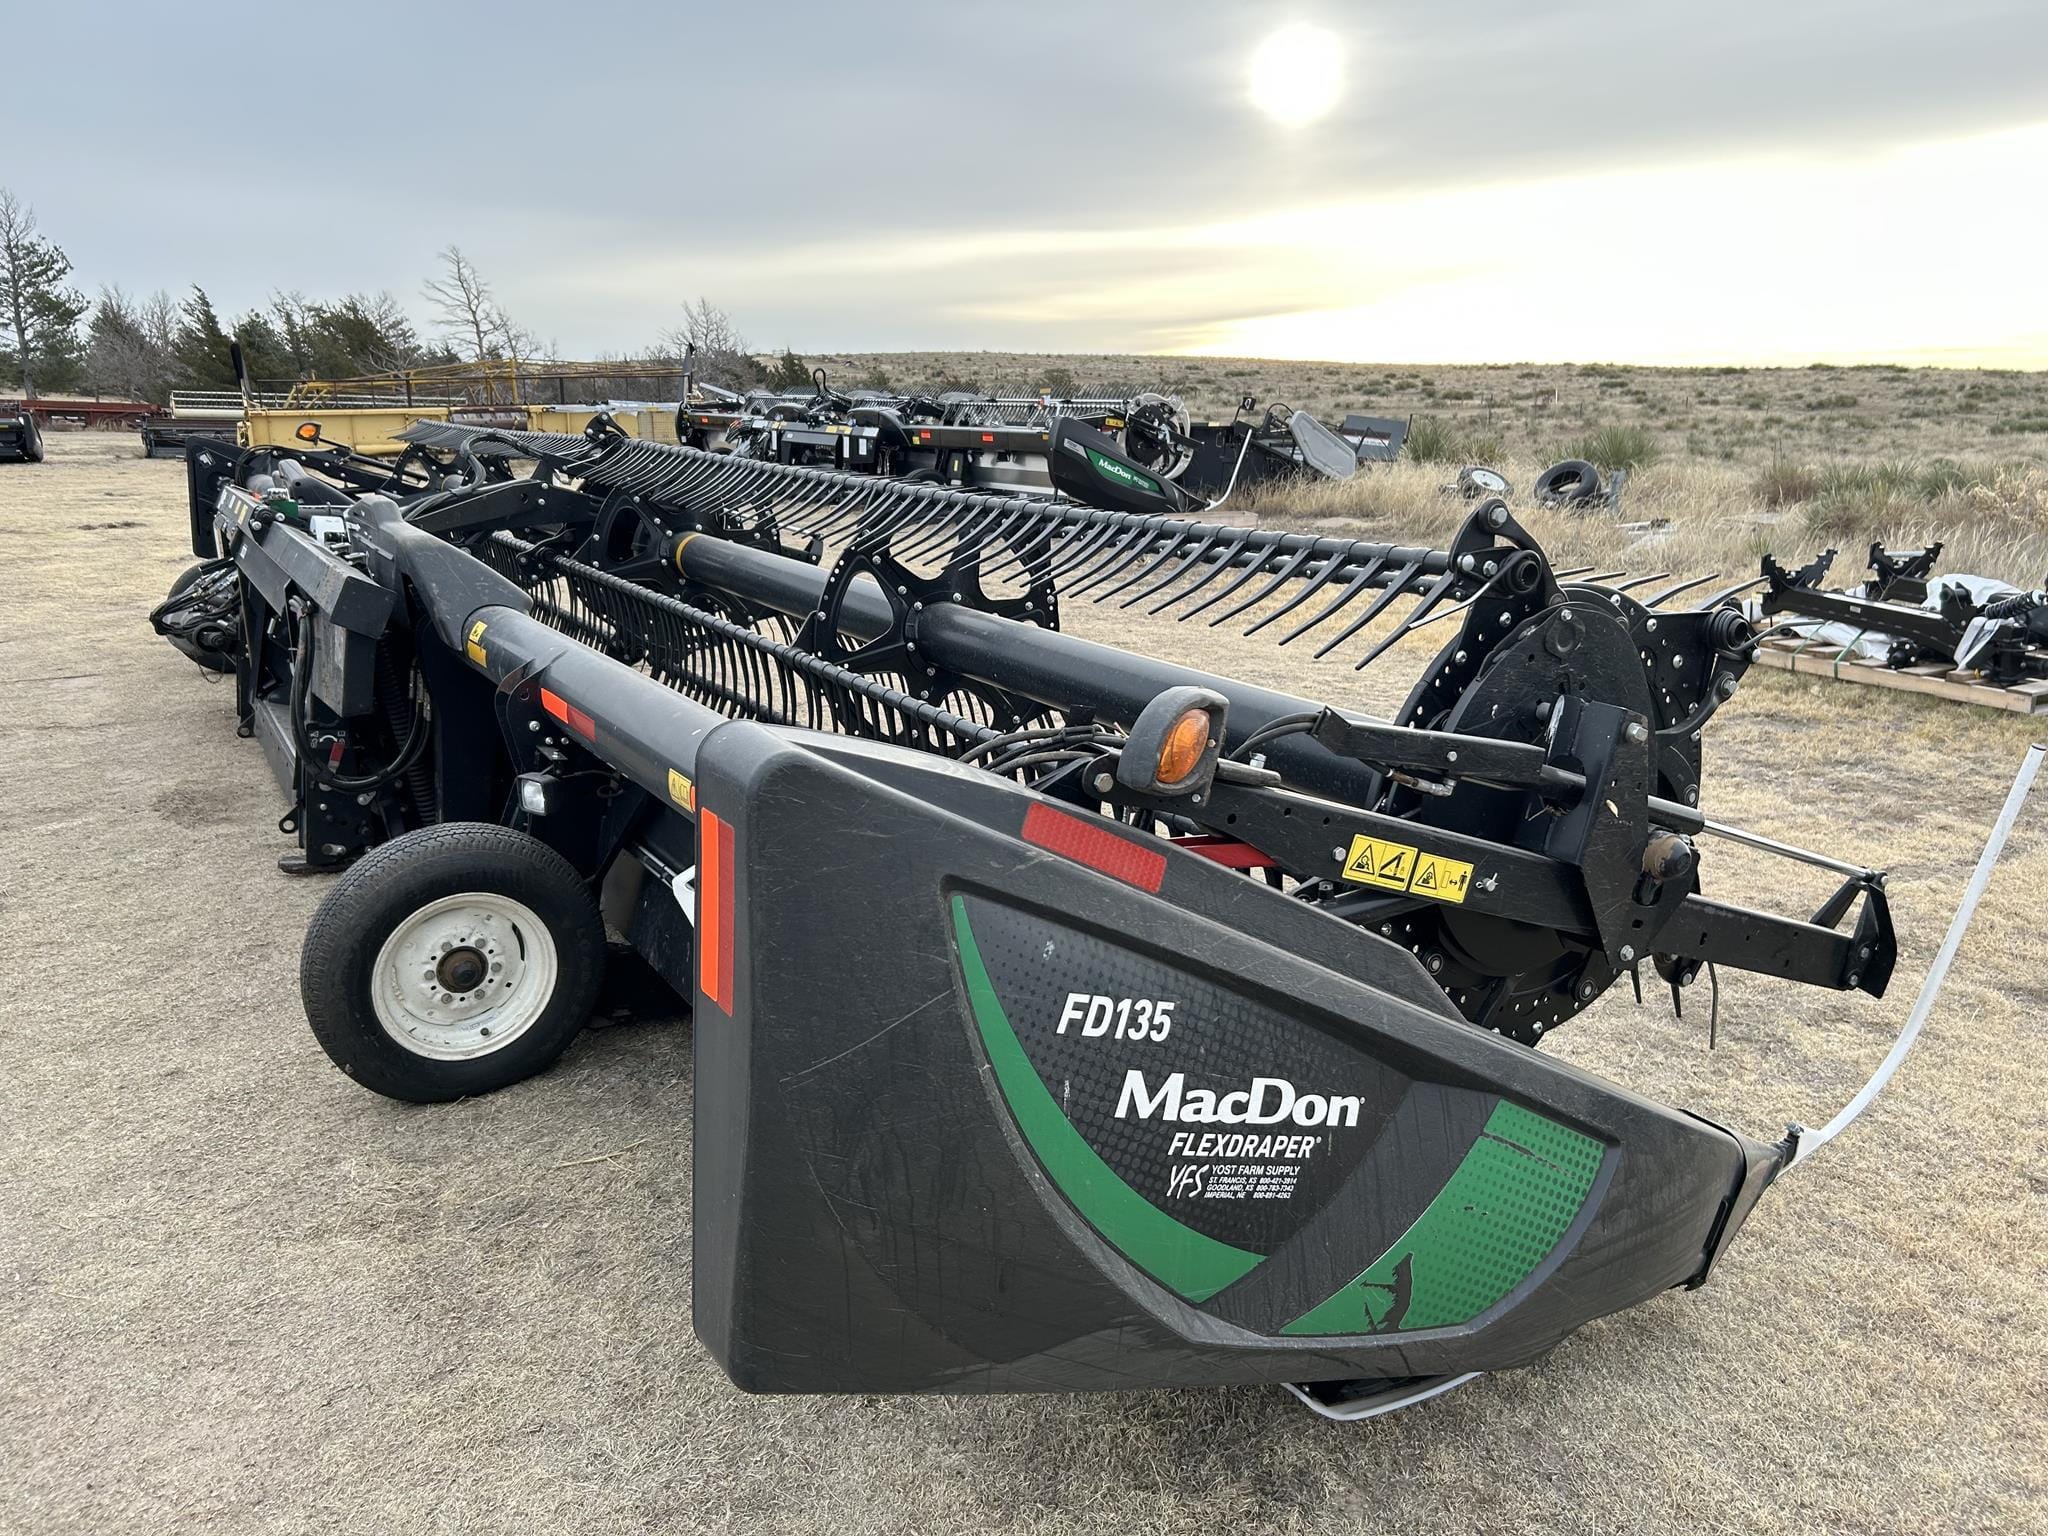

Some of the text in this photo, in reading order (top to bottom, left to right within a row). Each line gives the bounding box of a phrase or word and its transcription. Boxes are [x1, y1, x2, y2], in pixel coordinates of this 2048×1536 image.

[1098, 458, 1132, 480] MacDon
[1056, 992, 1176, 1042] FD135
[1114, 1069, 1362, 1127] MacDon
[1167, 1132, 1316, 1158] FLEXDRAPER
[1212, 1164, 1300, 1176] YOST FARM SUPPLY
[1219, 1176, 1247, 1185] FRANCIS,
[1166, 1164, 1209, 1200] YFS
[1206, 1184, 1244, 1192] GOODLAND,
[1204, 1191, 1235, 1199] IMPERIAL,
